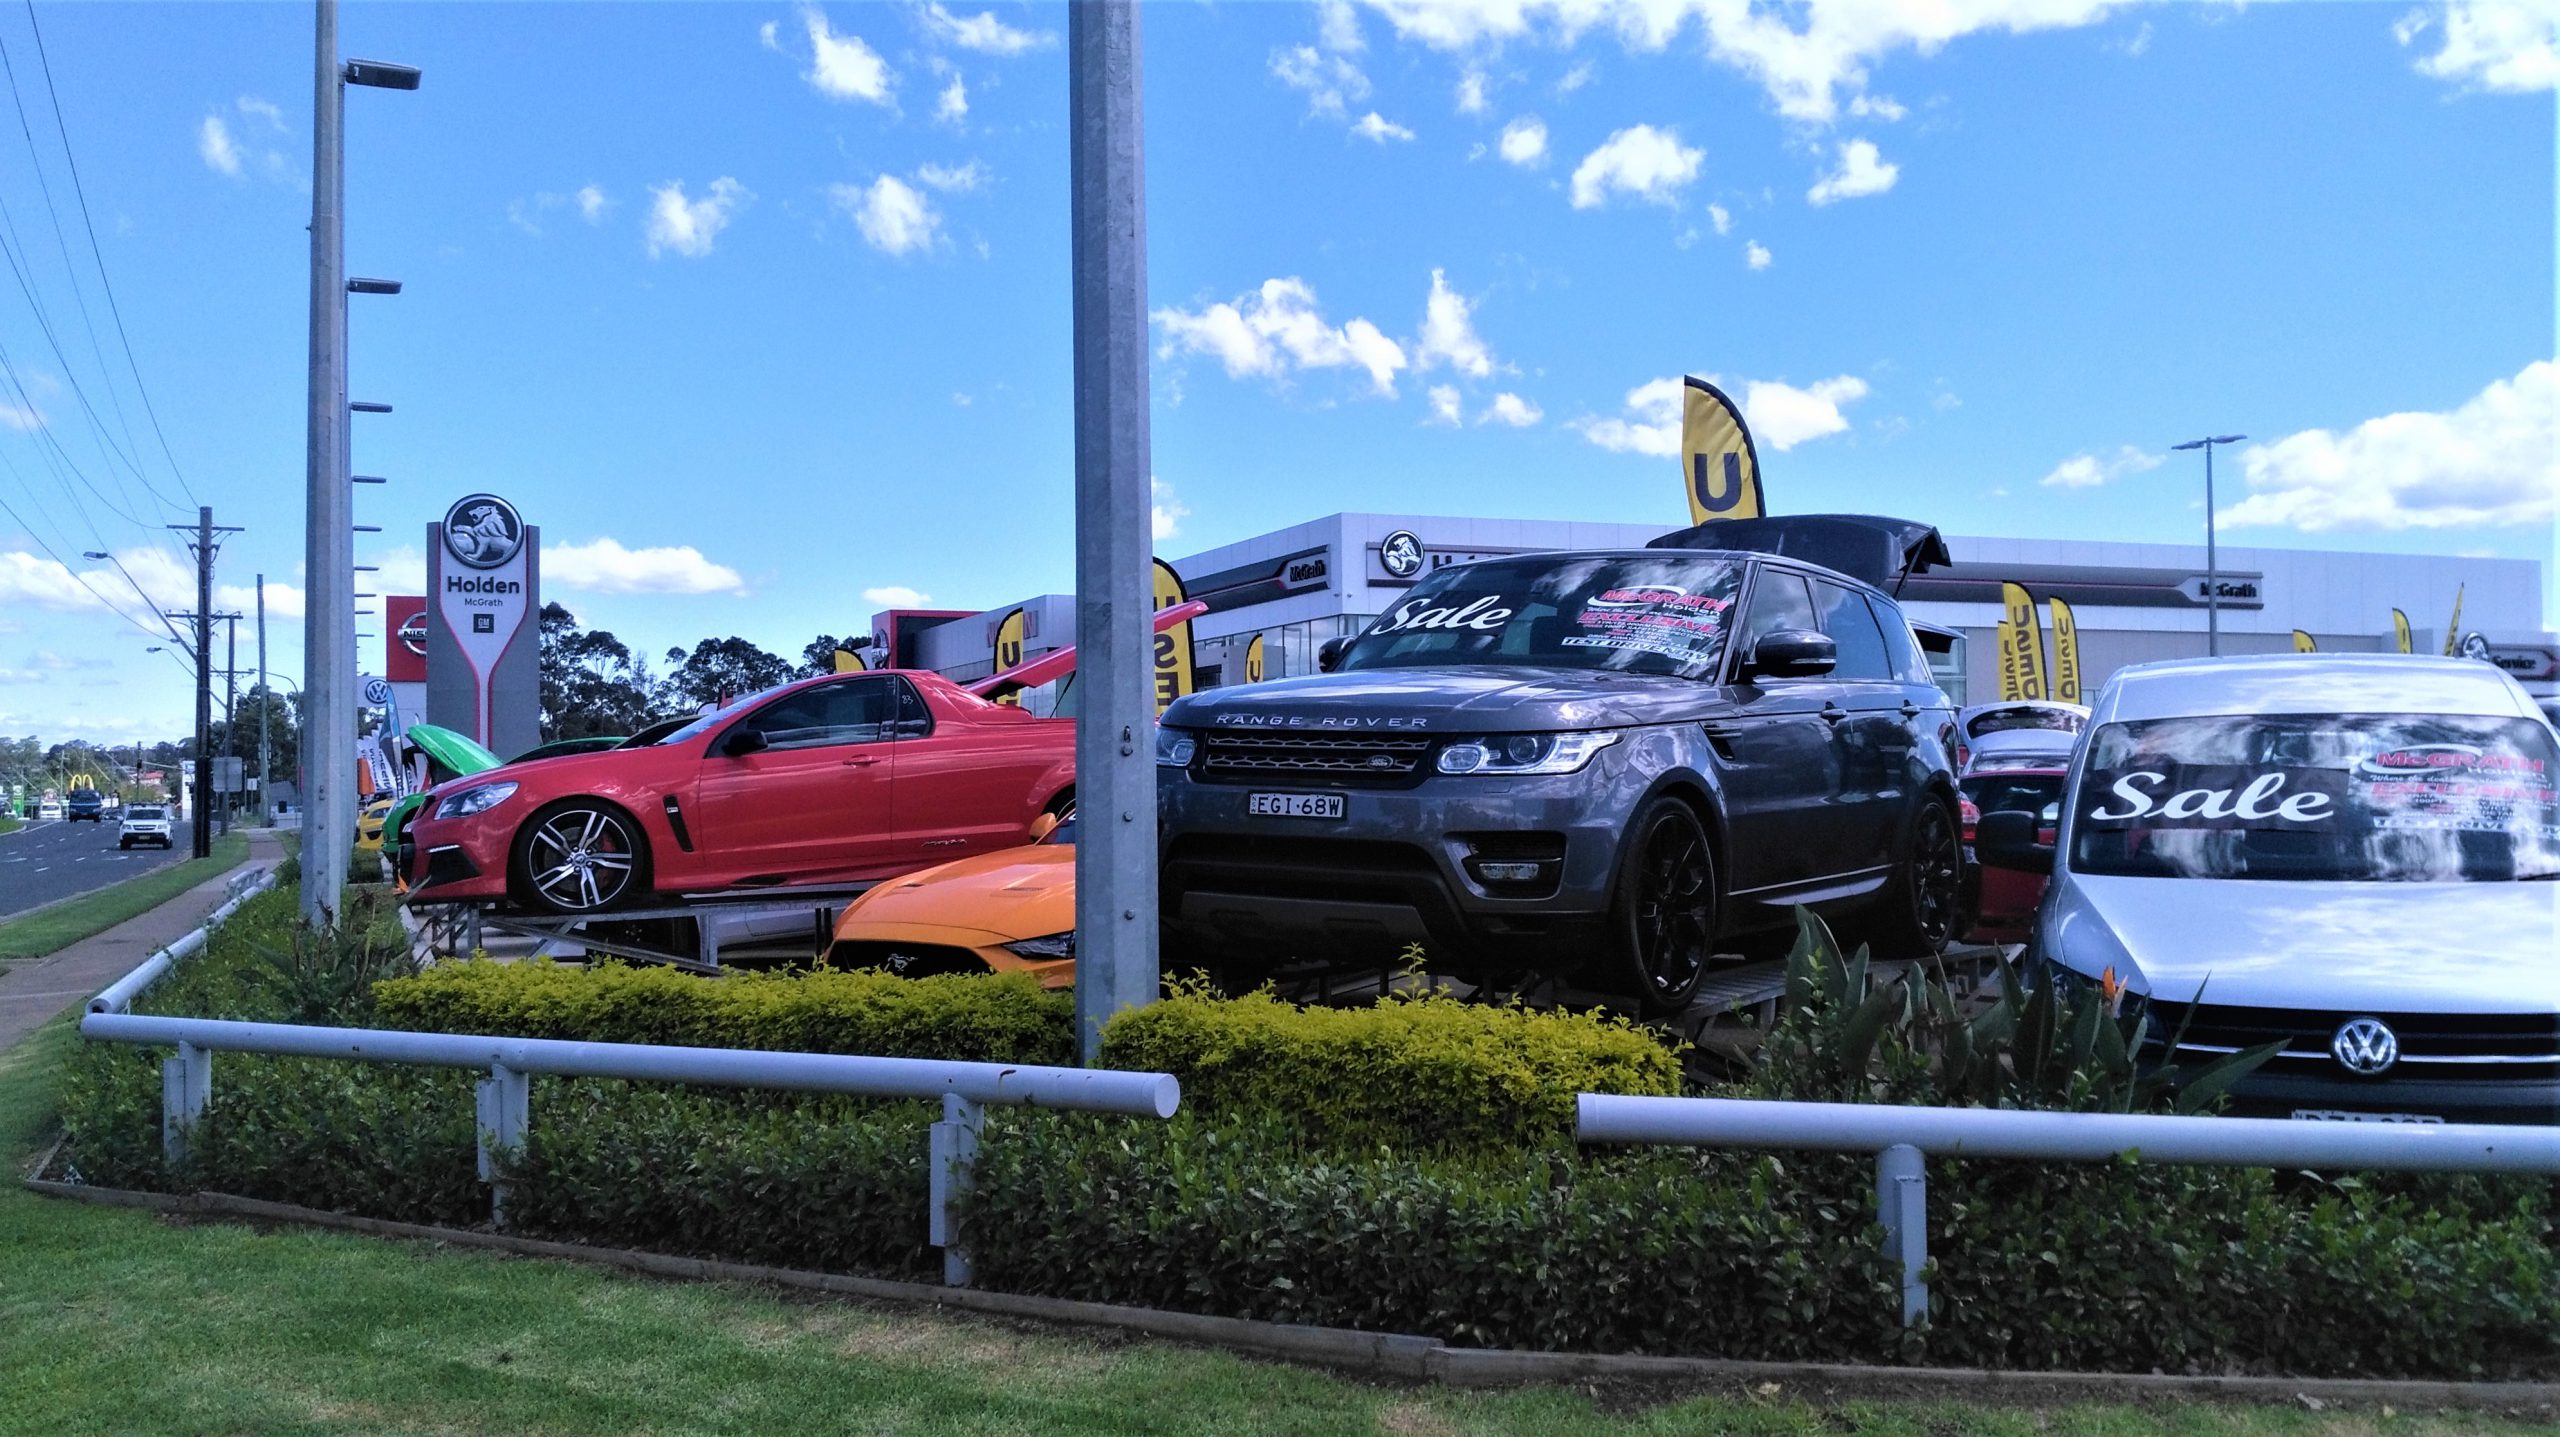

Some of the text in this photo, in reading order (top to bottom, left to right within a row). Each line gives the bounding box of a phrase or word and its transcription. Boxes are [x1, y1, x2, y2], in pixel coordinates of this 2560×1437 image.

[1694, 453, 1741, 526] U
[1290, 560, 1327, 582] McGrath
[447, 576, 520, 594] Holden
[464, 598, 503, 607] McGrath
[1601, 590, 1729, 612] McGRATH
[1662, 603, 1720, 616] Holden
[1370, 595, 1512, 636] Sale
[404, 630, 427, 638] NIS
[902, 694, 913, 705] 83
[1216, 715, 1428, 728] RANGE ROVER
[2376, 752, 2545, 773] McGRATH
[2090, 771, 2334, 822] Sale
